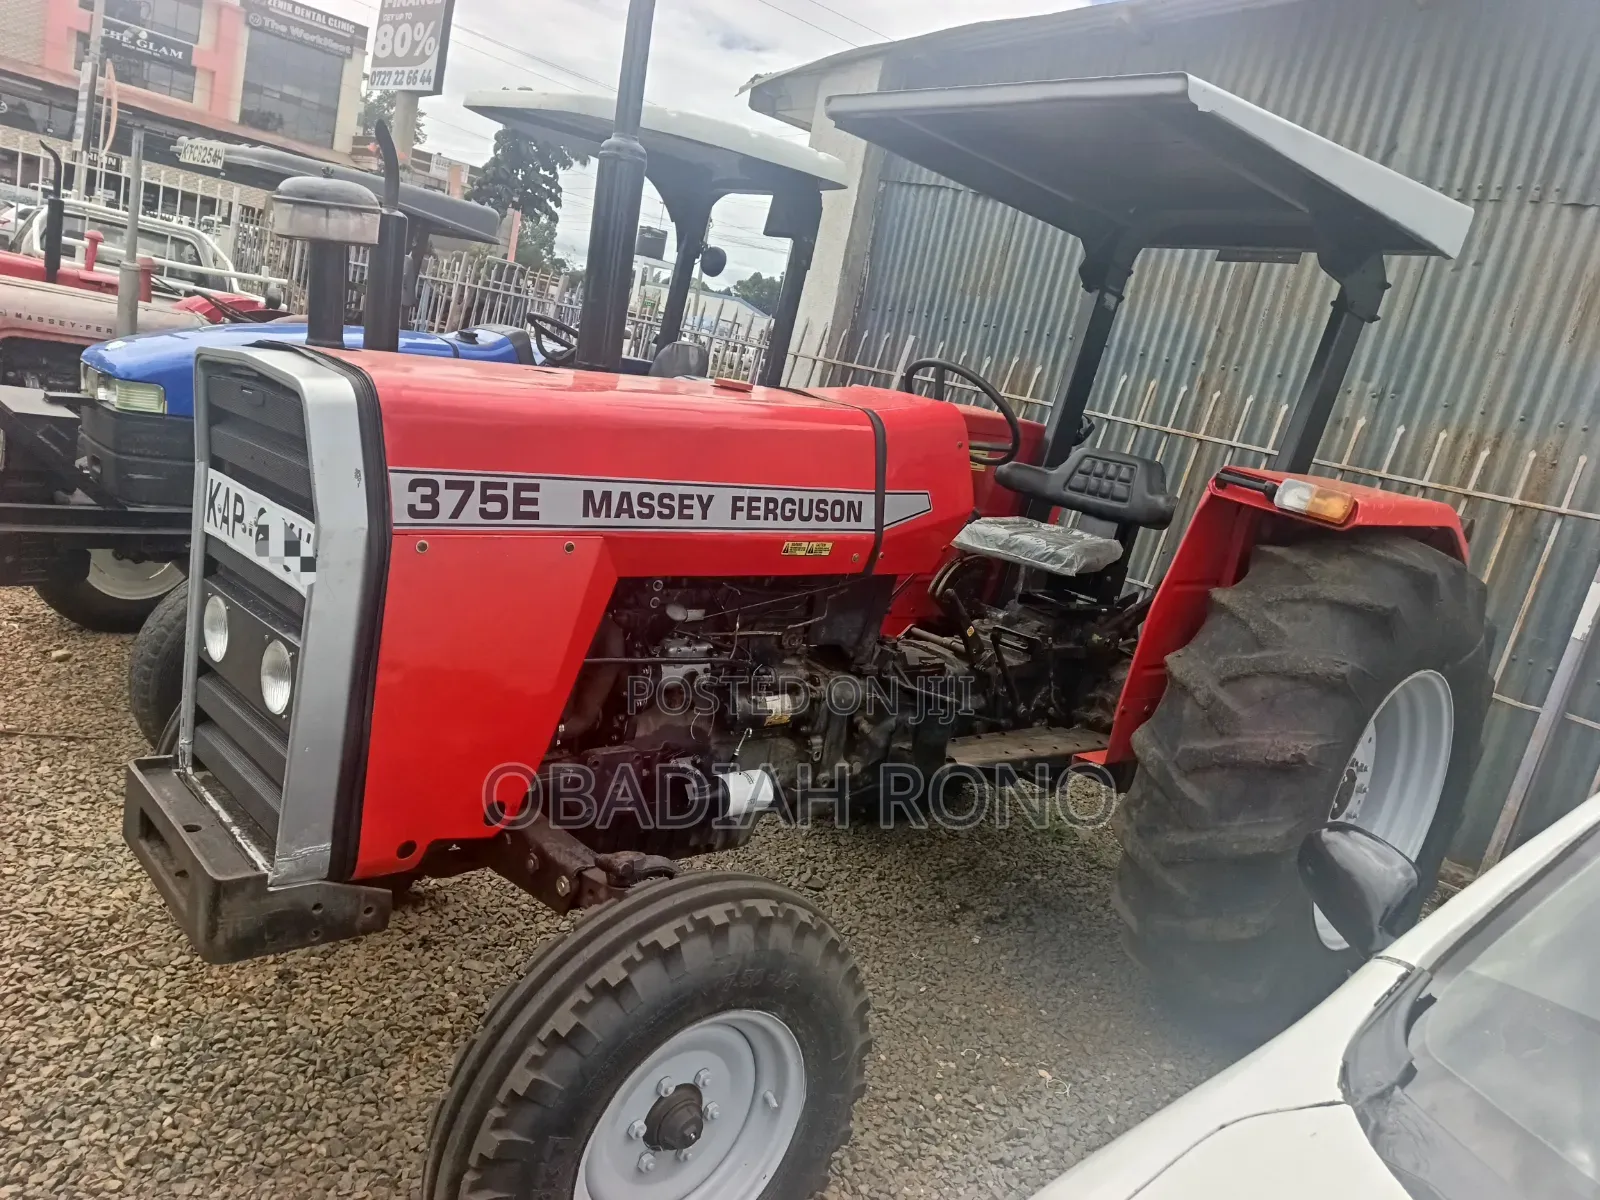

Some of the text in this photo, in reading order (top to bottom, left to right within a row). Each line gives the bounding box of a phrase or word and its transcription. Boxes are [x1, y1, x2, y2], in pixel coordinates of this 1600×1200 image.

[294, 5, 327, 24] DENTAL
[328, 17, 355, 34] CLINIC
[405, 12, 412, 20] TO
[136, 39, 184, 59] GLAM
[375, 21, 436, 58] 80%
[370, 69, 432, 86] 0727 22 66 44
[407, 478, 863, 523] 375E MASSEY FERGUSON
